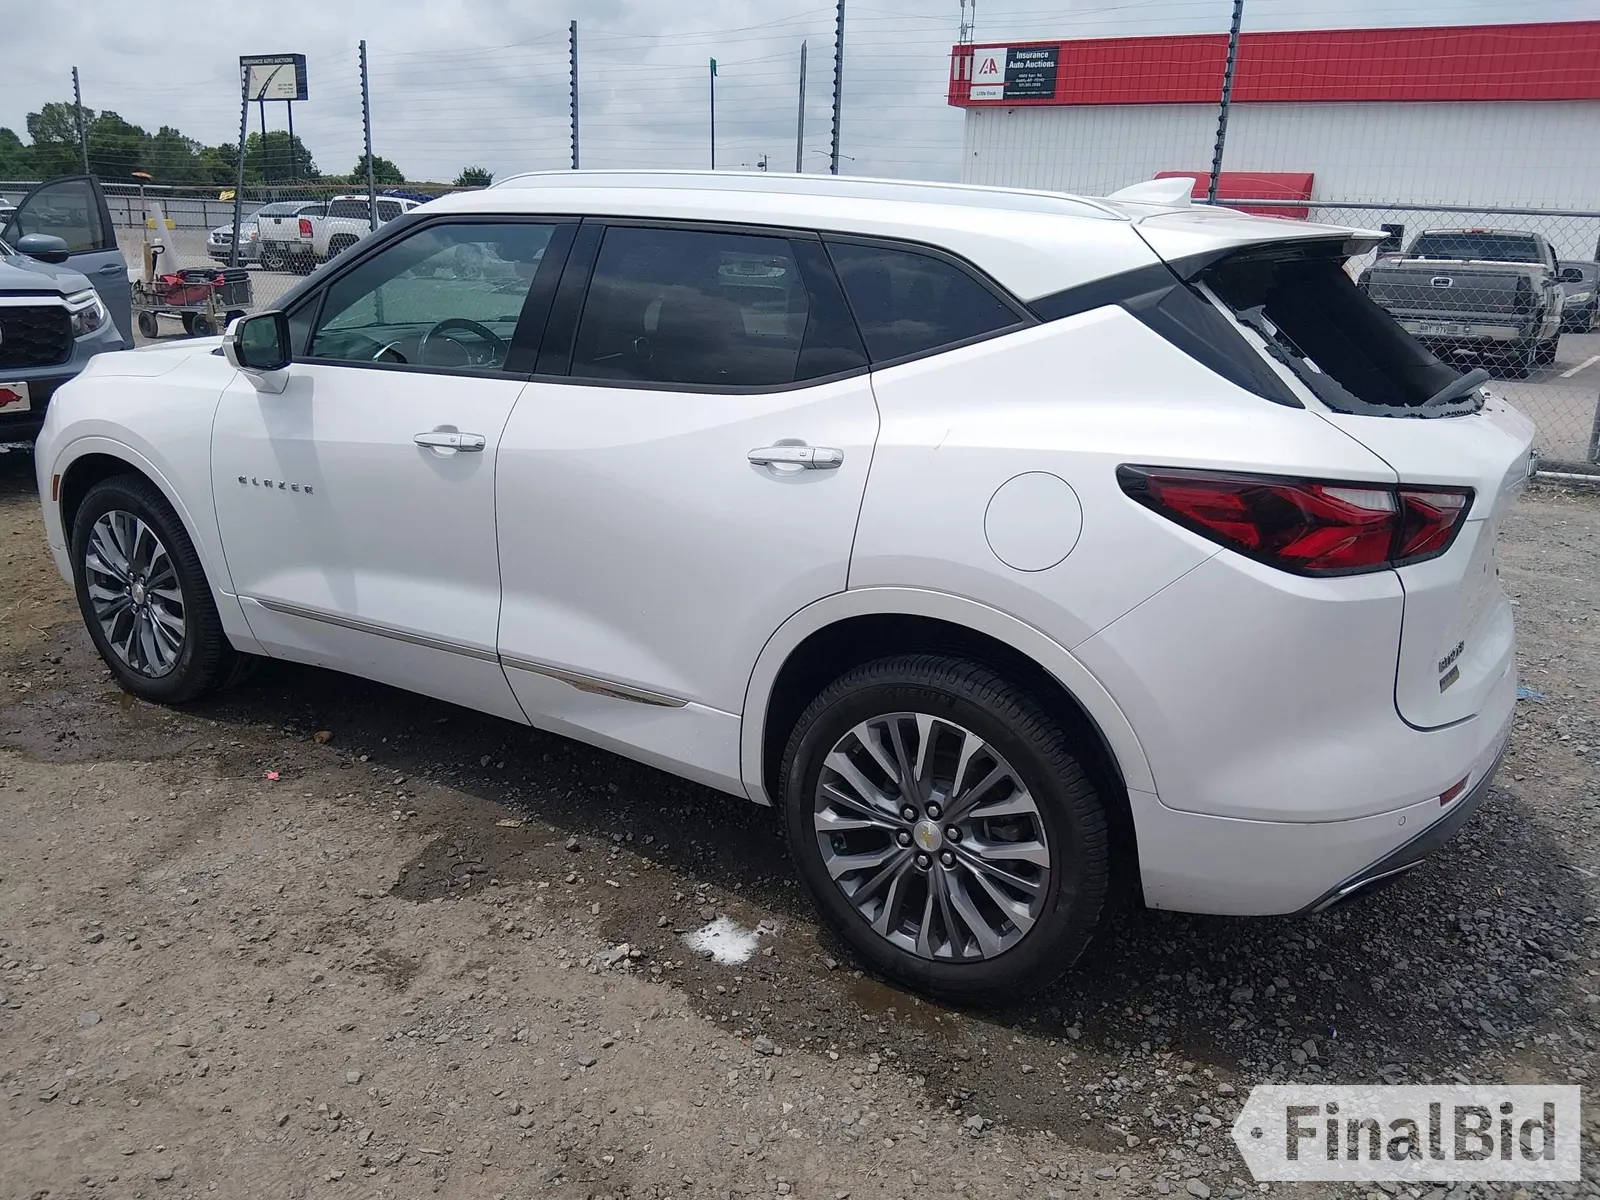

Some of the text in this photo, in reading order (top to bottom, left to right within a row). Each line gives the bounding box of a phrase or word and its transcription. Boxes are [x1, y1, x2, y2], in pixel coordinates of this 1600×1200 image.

[1016, 50, 1049, 60] Insurance
[1009, 59, 1055, 69] Auto Auctions
[237, 475, 314, 495] BLAZER
